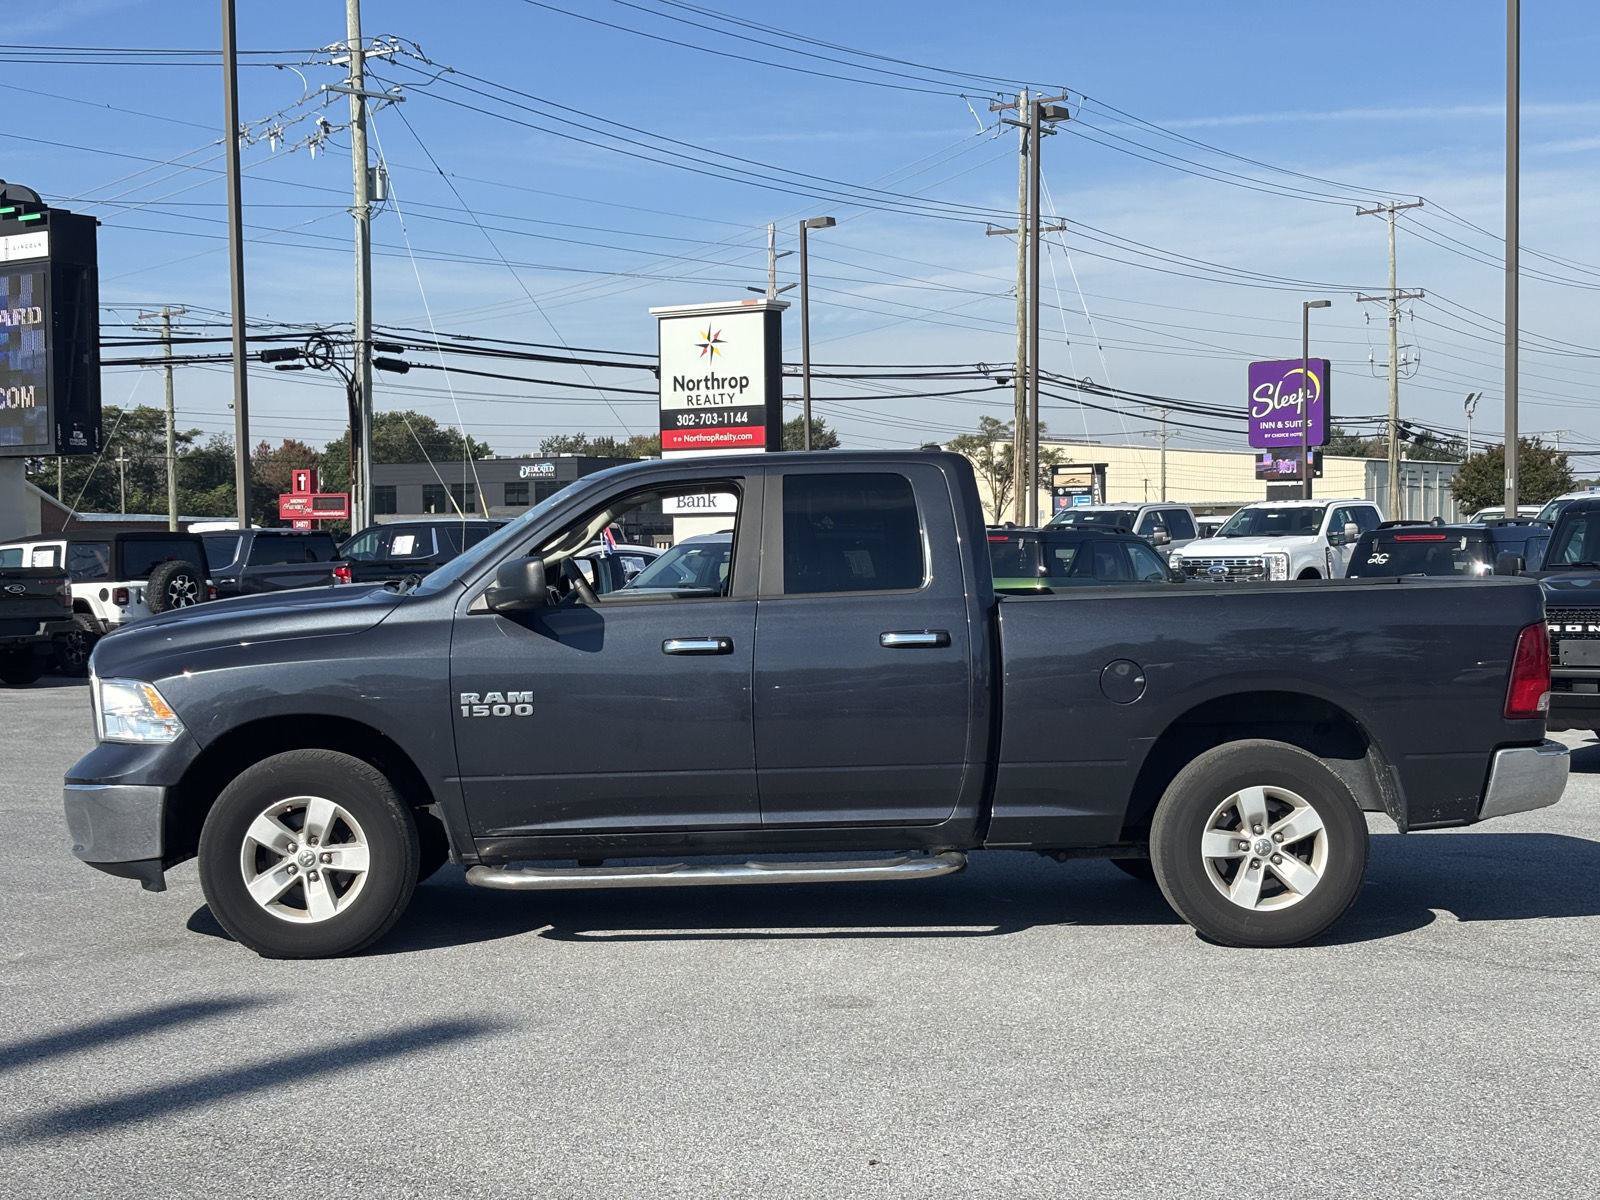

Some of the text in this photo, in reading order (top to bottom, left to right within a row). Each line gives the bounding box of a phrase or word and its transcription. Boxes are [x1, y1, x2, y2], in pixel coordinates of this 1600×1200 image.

[673, 372, 749, 394] Northrop
[686, 393, 735, 407] REALTY
[676, 411, 748, 427] 302-703-1144
[1260, 419, 1312, 429] INN & SUITS
[683, 432, 753, 443] NorthropRealty.com
[676, 493, 718, 508] Bank
[460, 691, 534, 704] RAM
[460, 704, 534, 717] 1500
